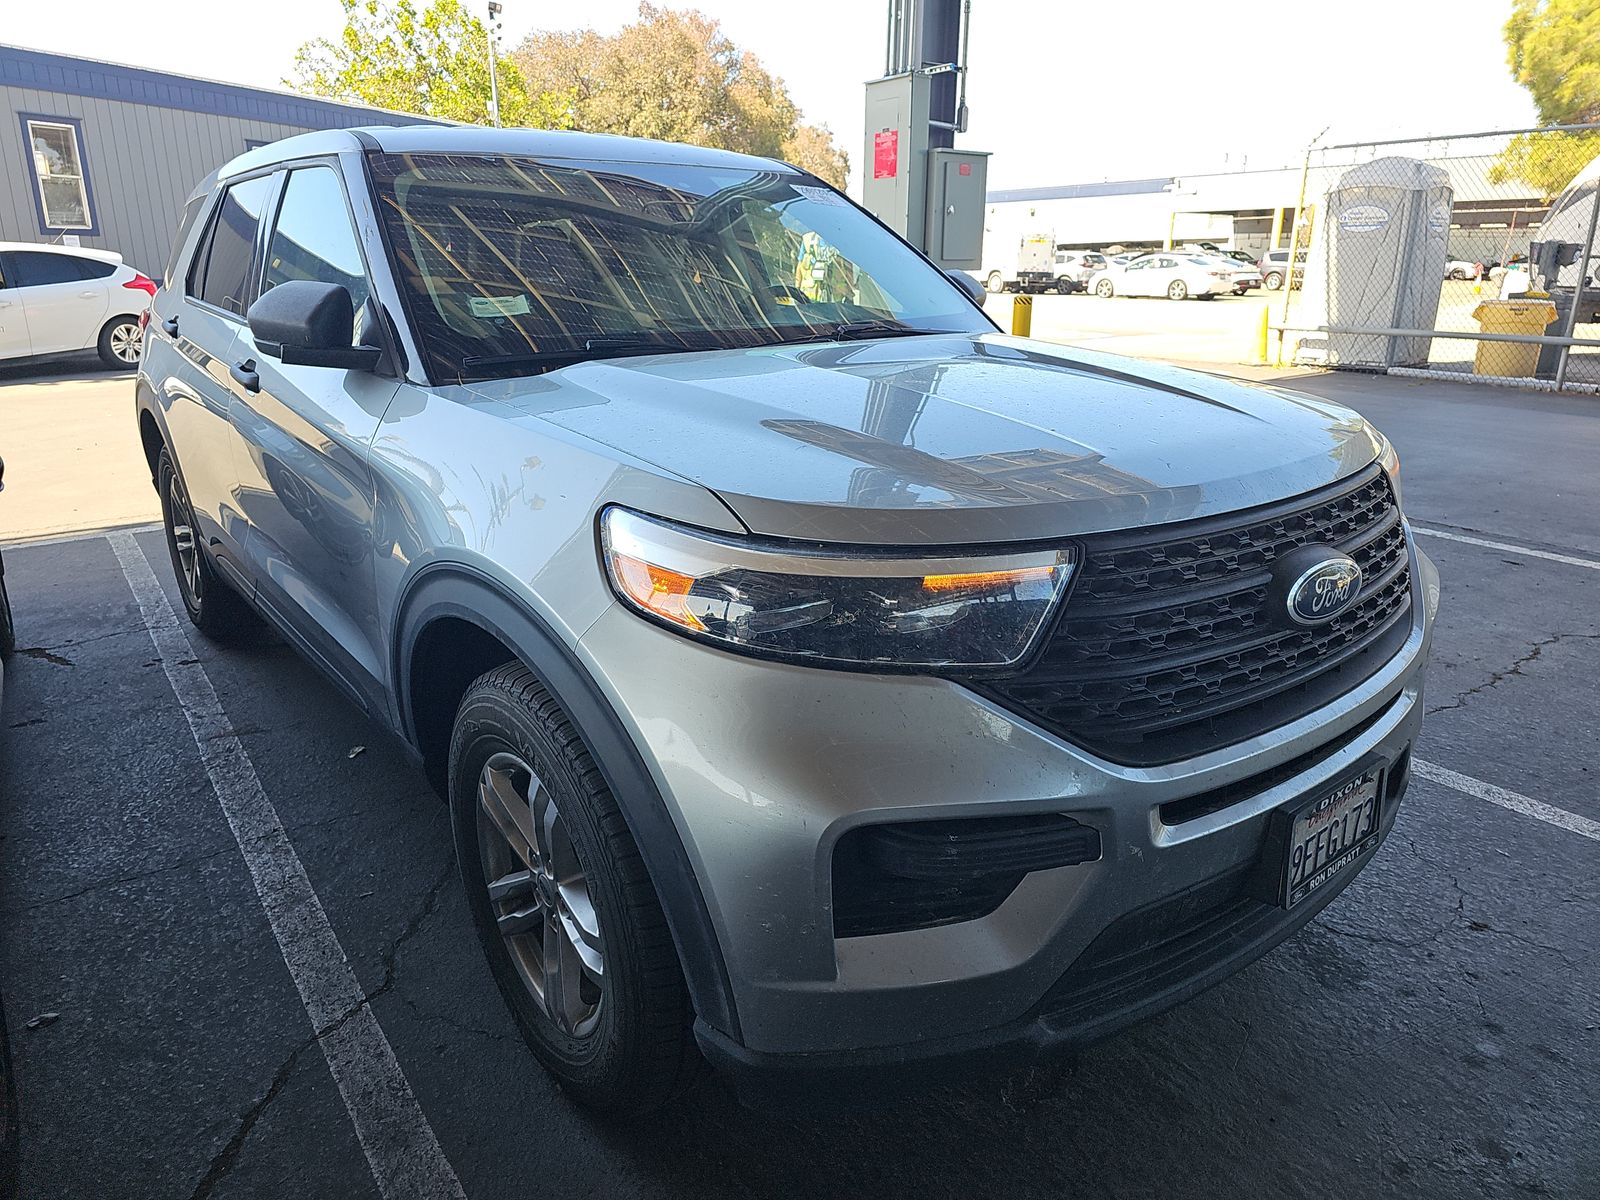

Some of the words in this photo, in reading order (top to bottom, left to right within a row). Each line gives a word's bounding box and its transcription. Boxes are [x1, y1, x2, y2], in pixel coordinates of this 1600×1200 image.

[1312, 573, 1351, 612] Ford
[1320, 776, 1363, 810] DIXON
[1291, 796, 1375, 886] 9FFG173
[1310, 871, 1326, 890] RON
[1327, 847, 1361, 877] DUPRATT
